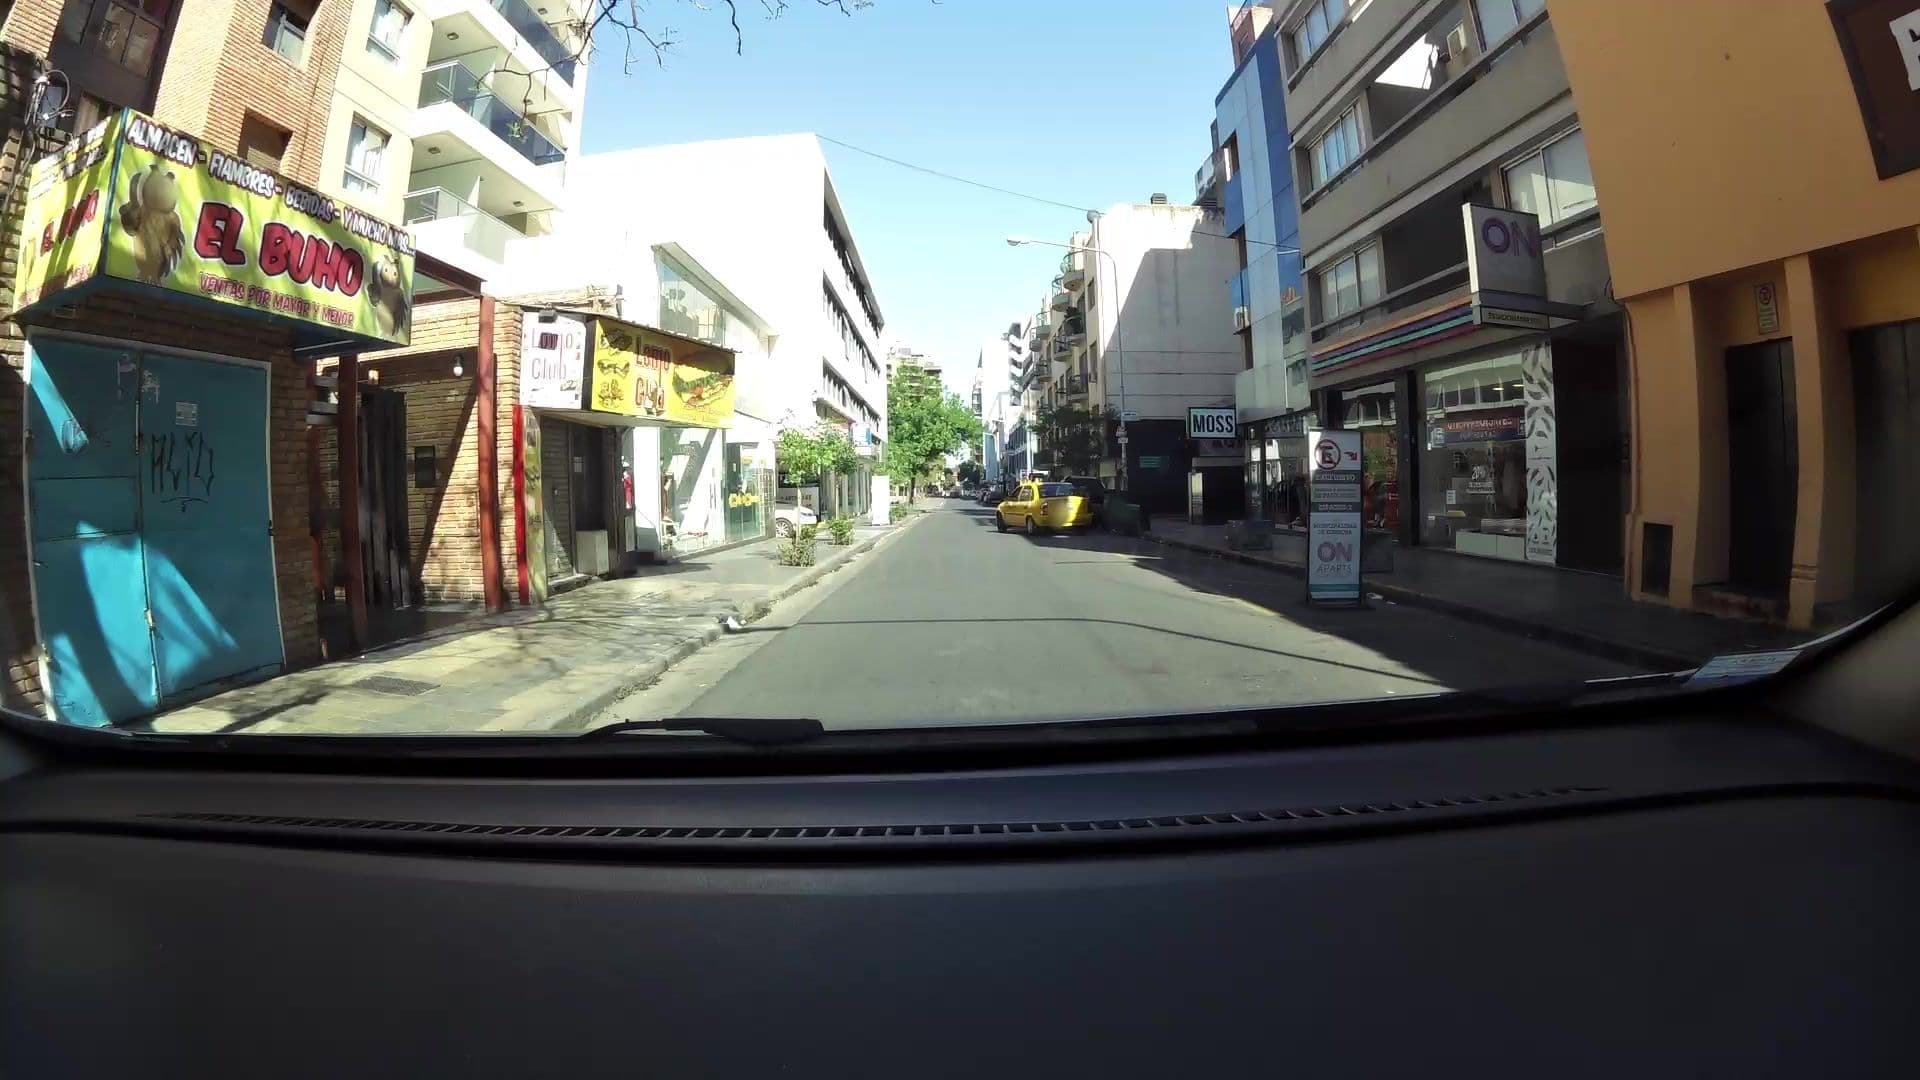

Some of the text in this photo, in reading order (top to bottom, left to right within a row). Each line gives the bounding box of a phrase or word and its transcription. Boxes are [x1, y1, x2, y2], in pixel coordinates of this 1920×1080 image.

[127, 116, 197, 168] ALMACEN
[209, 151, 274, 198] FIAMBRES
[284, 182, 334, 223] BEBIDAS
[194, 202, 363, 297] EL BUHO
[1482, 217, 1539, 258] ON
[200, 272, 245, 299] VENTAS
[248, 285, 271, 309] POR
[272, 291, 311, 319] MAYOR
[321, 304, 354, 328] MENOR
[1193, 414, 1233, 433] MOSS
[1317, 541, 1353, 562] ON
